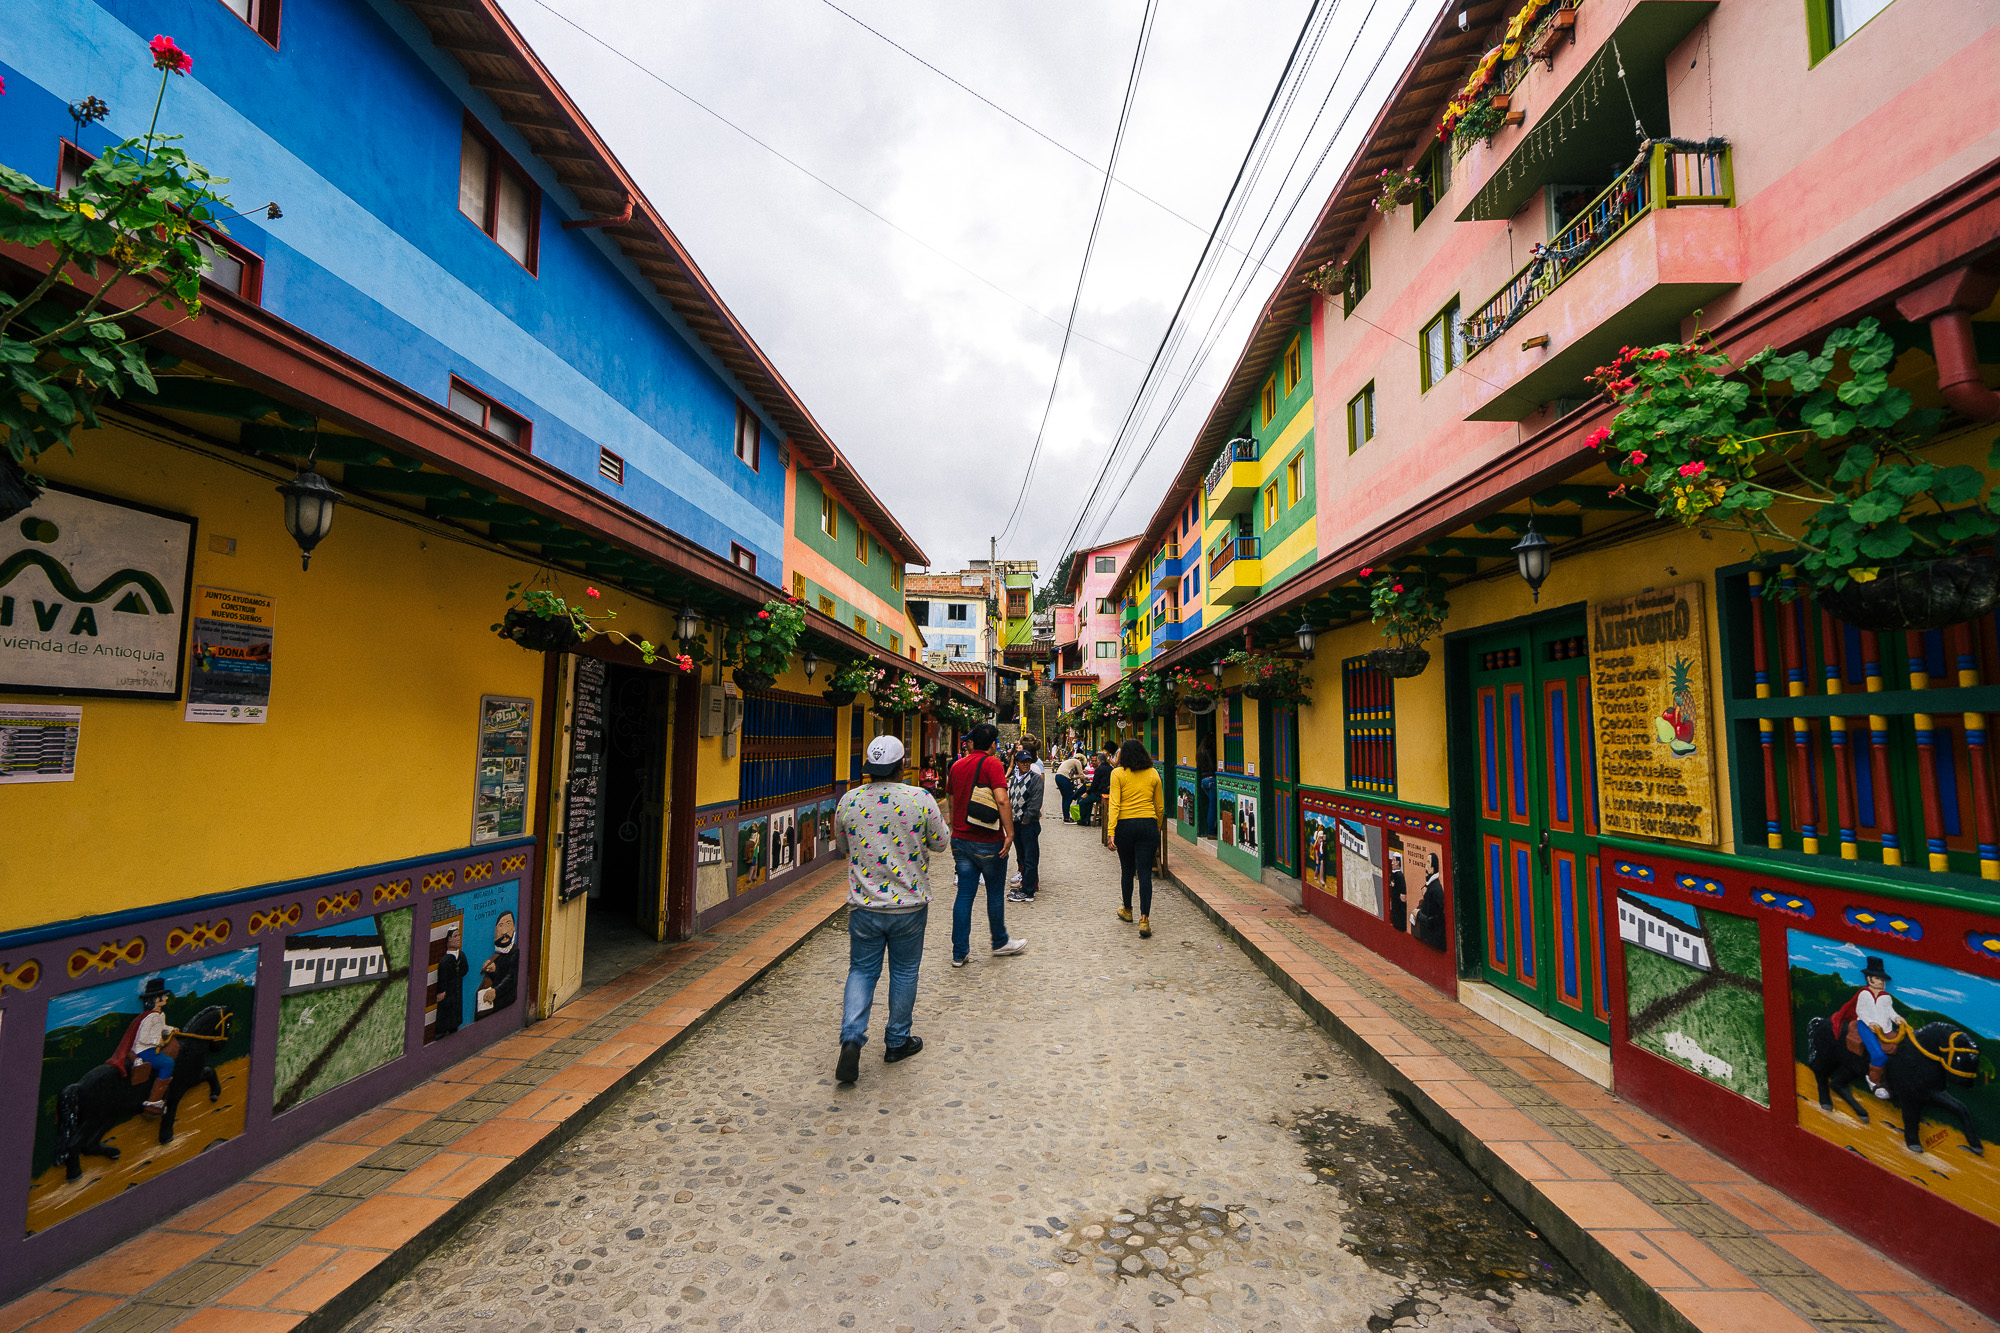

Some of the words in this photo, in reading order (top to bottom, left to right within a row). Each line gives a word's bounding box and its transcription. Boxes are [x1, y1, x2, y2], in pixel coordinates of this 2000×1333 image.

[204, 590, 231, 601] JUNTOS
[232, 595, 266, 607] AYUDAMOS
[220, 602, 256, 614] CONSTRUIR
[211, 610, 238, 620] NUEVOS
[240, 612, 262, 623] SUEÑOS
[67, 641, 88, 654] de
[93, 644, 164, 662] Antioquia
[218, 646, 245, 658] DONA
[1595, 656, 1634, 670] Papas
[1596, 666, 1661, 685] Zanahoria
[1597, 683, 1646, 702] Repollo
[1598, 700, 1648, 714] Tomate
[1599, 716, 1648, 730] Cebolla
[1600, 730, 1650, 745] Cilantro
[1601, 746, 1653, 762] Arvejas
[1602, 762, 1682, 778] Habichuelas
[1602, 776, 1644, 791] Frutas
[1646, 782, 1654, 796] y
[1656, 780, 1687, 796] más
[1613, 796, 1626, 810] los
[473, 889, 493, 899] NOTARIA
[474, 899, 496, 910] REGISTRO
[474, 909, 496, 920] CONTROL
